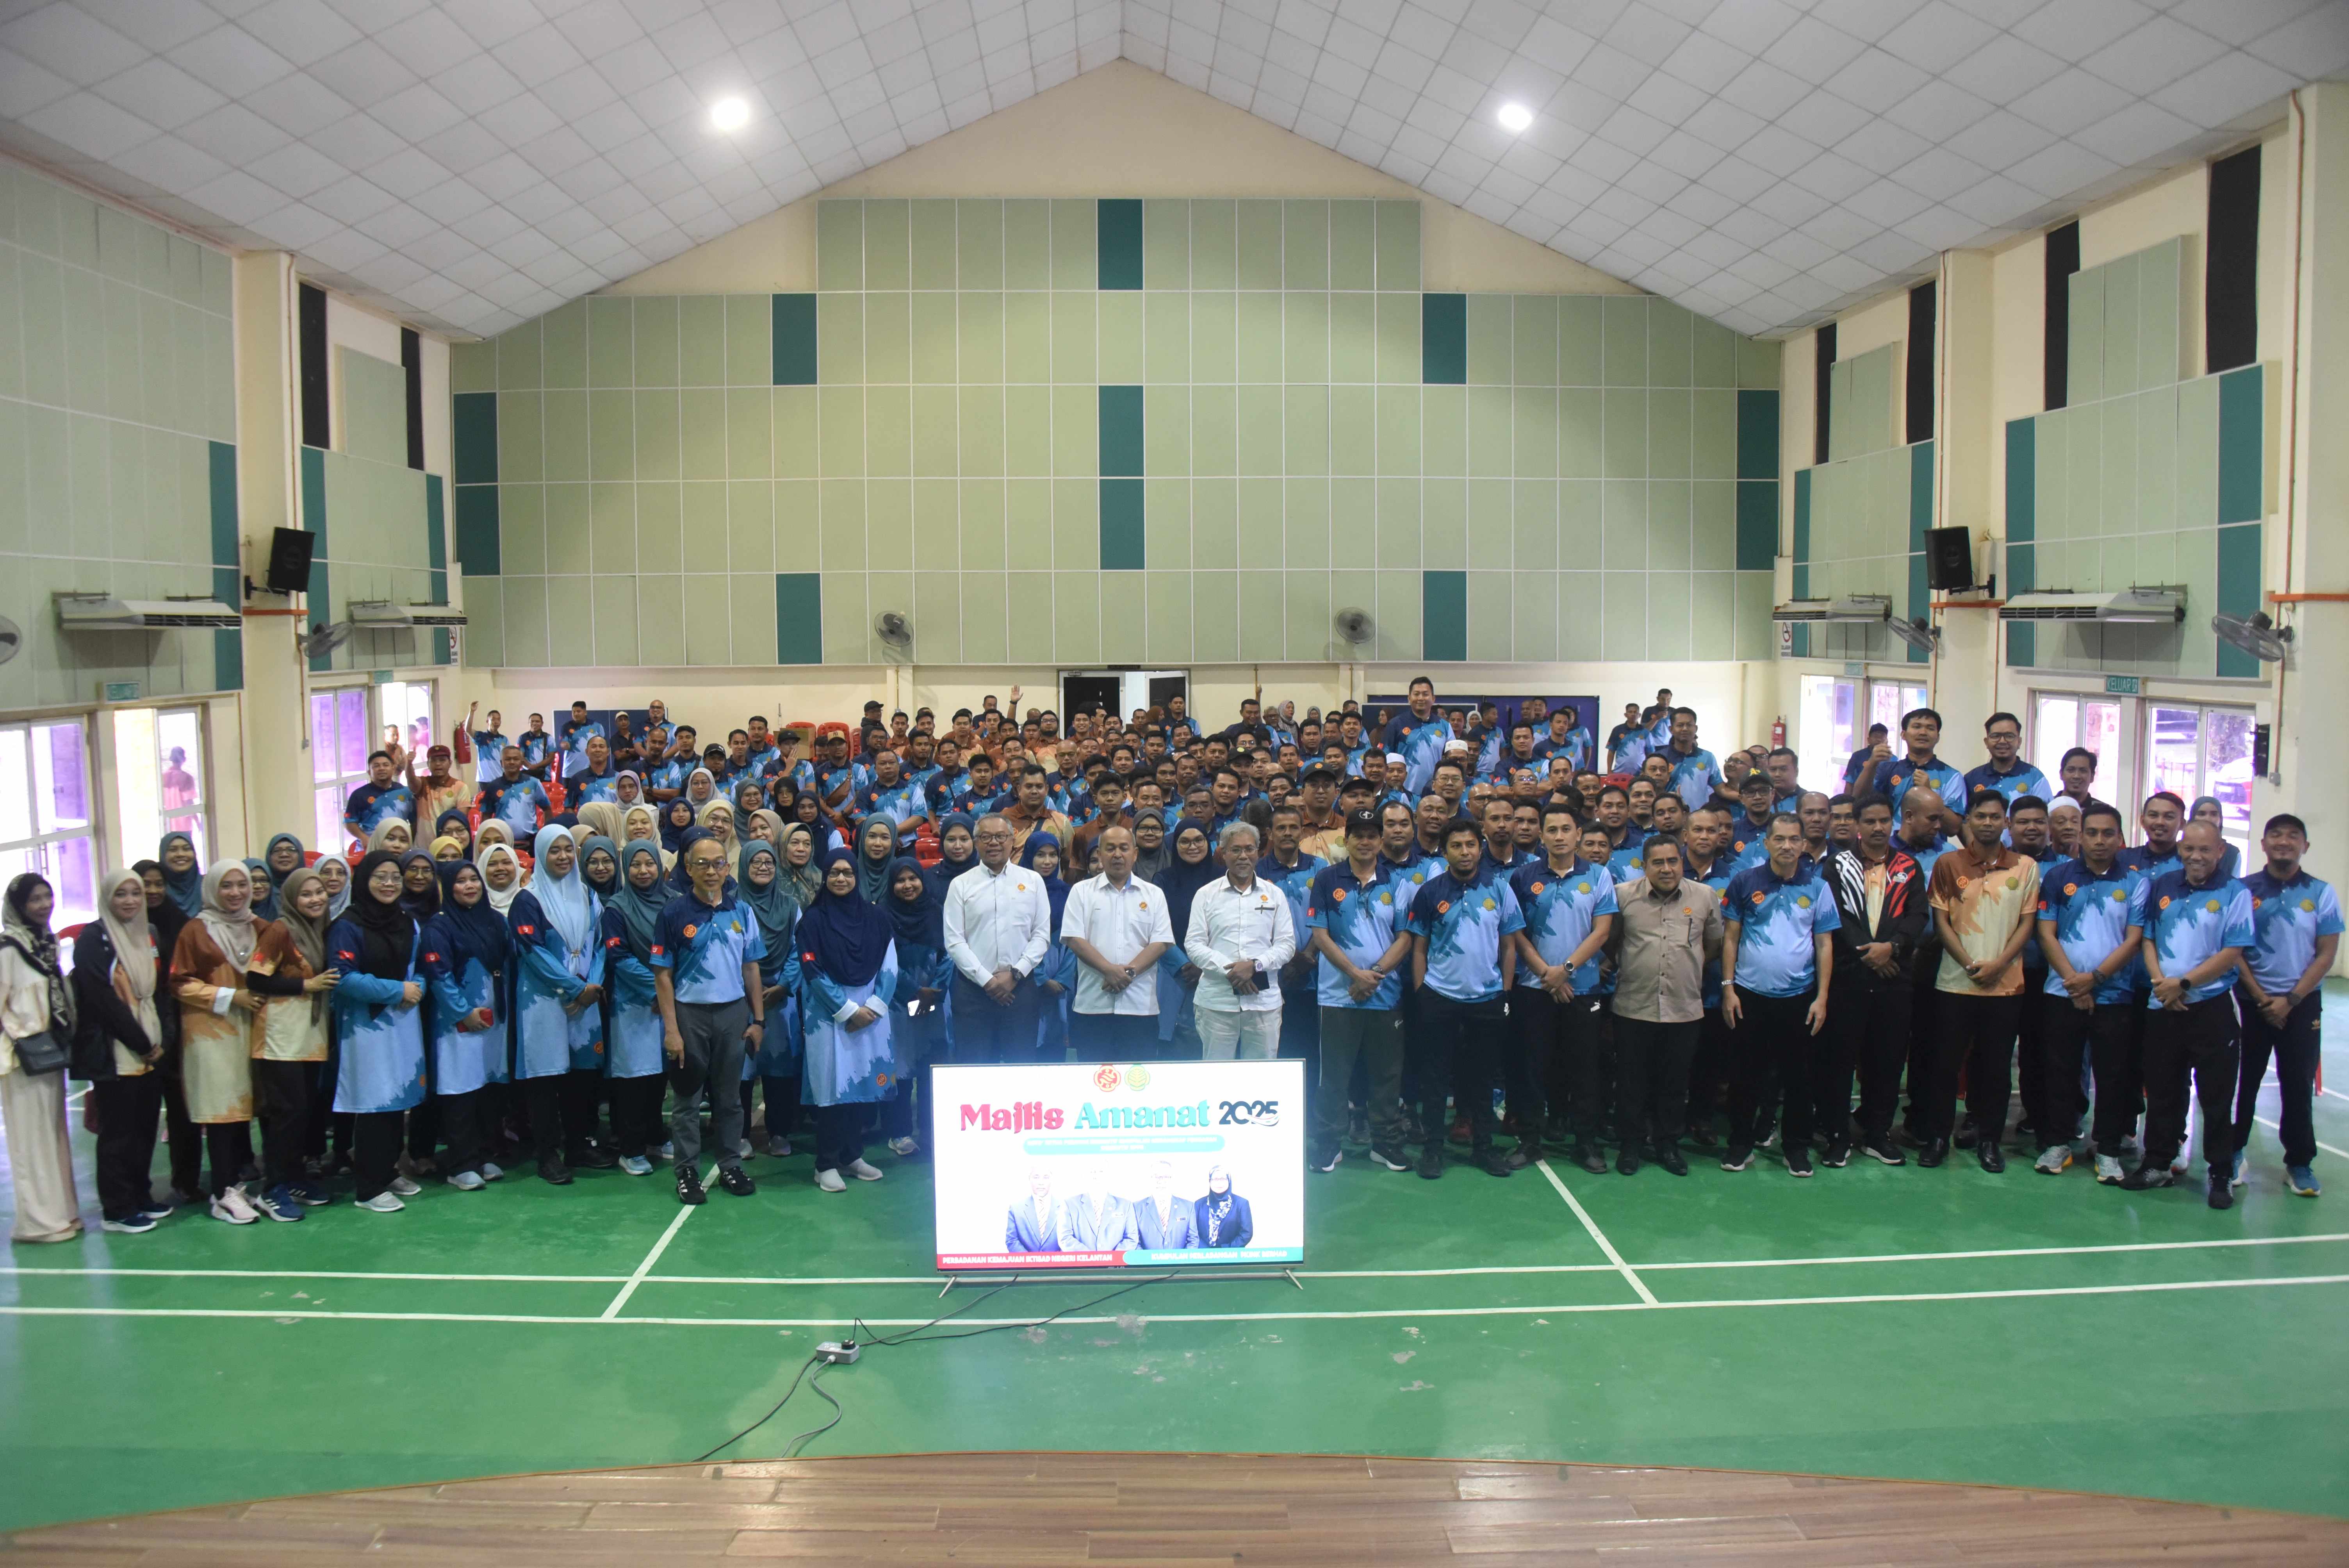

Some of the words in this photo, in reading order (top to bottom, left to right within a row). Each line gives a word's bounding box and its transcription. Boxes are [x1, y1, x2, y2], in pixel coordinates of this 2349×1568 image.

[2107, 677, 2131, 691] KELUAR
[960, 1101, 1064, 1134] Majlis
[1074, 1099, 1210, 1129] Amanat
[1219, 1100, 1279, 1127] 2025
